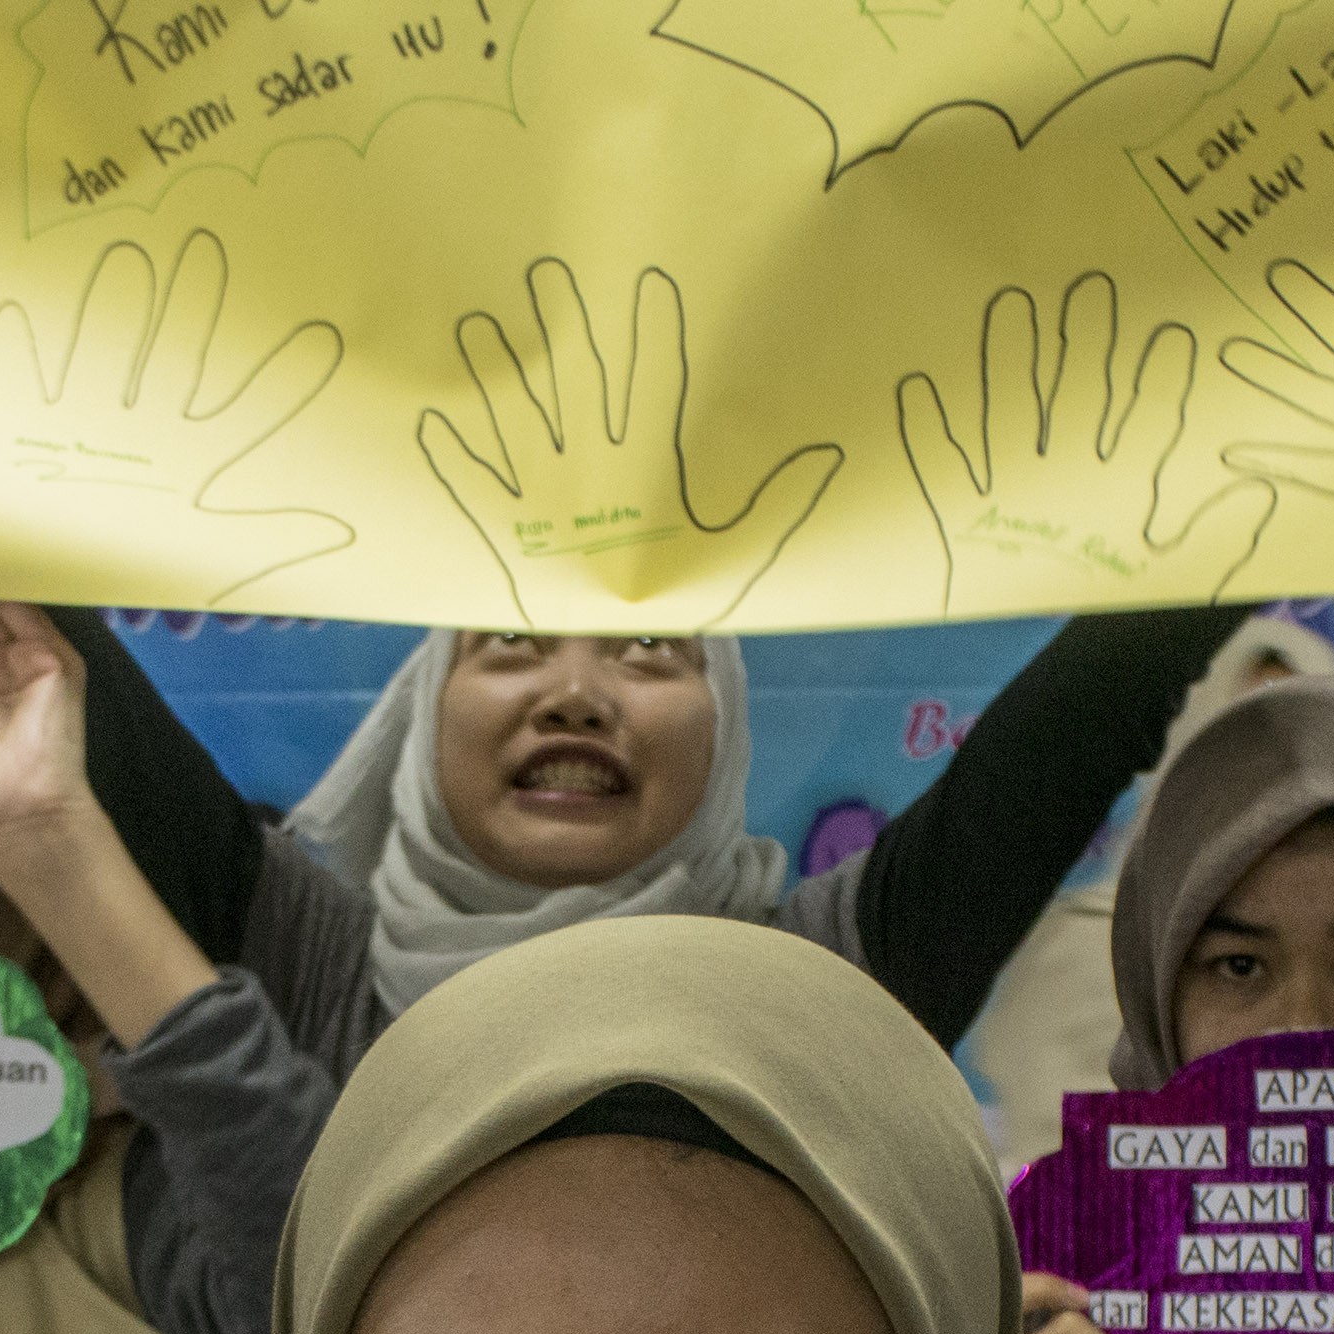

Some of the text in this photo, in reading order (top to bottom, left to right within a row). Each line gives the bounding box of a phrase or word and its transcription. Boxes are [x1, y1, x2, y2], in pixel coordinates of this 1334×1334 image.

[62, 158, 128, 205] dan
[257, 52, 354, 118] sadar
[1111, 1131, 1224, 1166] GAYA
[1249, 1131, 1308, 1166] dan
[1193, 1187, 1308, 1222] KAMU
[1181, 1239, 1300, 1271] AMAN
[1091, 1291, 1147, 1328] dari
